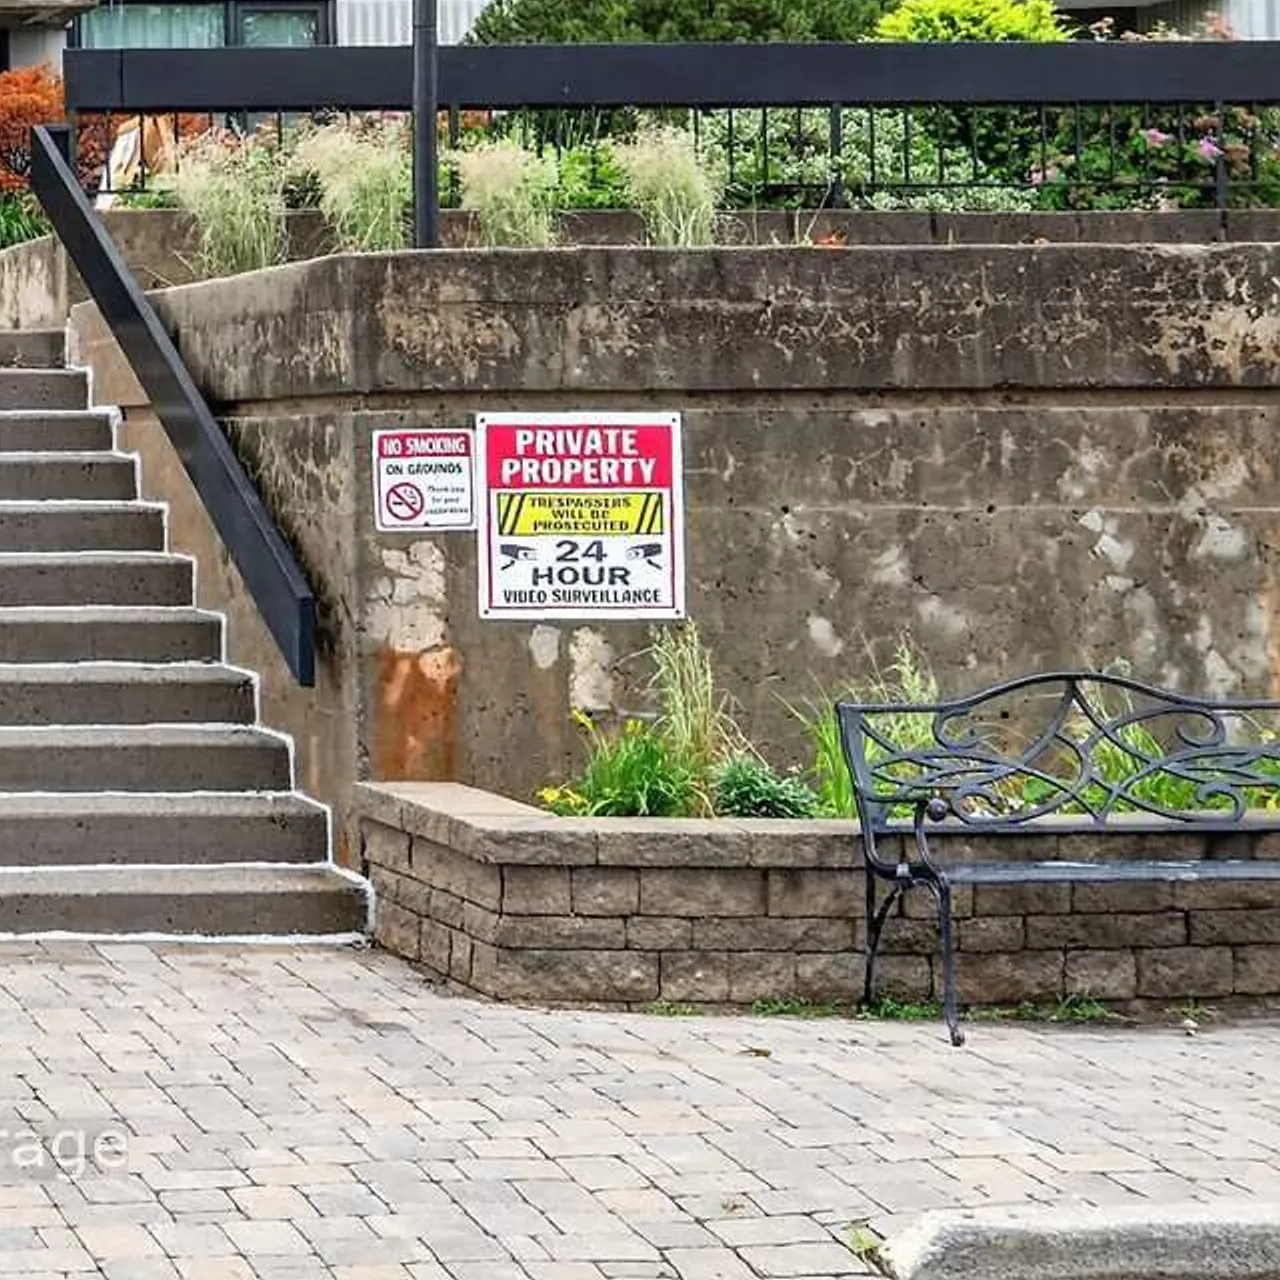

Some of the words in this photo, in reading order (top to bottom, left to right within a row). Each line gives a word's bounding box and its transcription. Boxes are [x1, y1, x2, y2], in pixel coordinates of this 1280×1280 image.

[383, 437, 402, 456] NO
[405, 436, 466, 455] SMOKING
[515, 428, 639, 456] PRIVATE
[386, 464, 404, 476] ON
[407, 462, 463, 476] GROUNDS
[501, 457, 657, 485] PROPERTY
[529, 497, 632, 508] TRESPASSERS
[551, 509, 584, 520] WILL
[589, 509, 611, 520] BE
[533, 520, 630, 532] PROSECUTED
[555, 539, 608, 562] 24
[532, 565, 631, 586] HOUR
[503, 589, 548, 604] VIDEO
[551, 589, 662, 604] SURVEILLANCE
